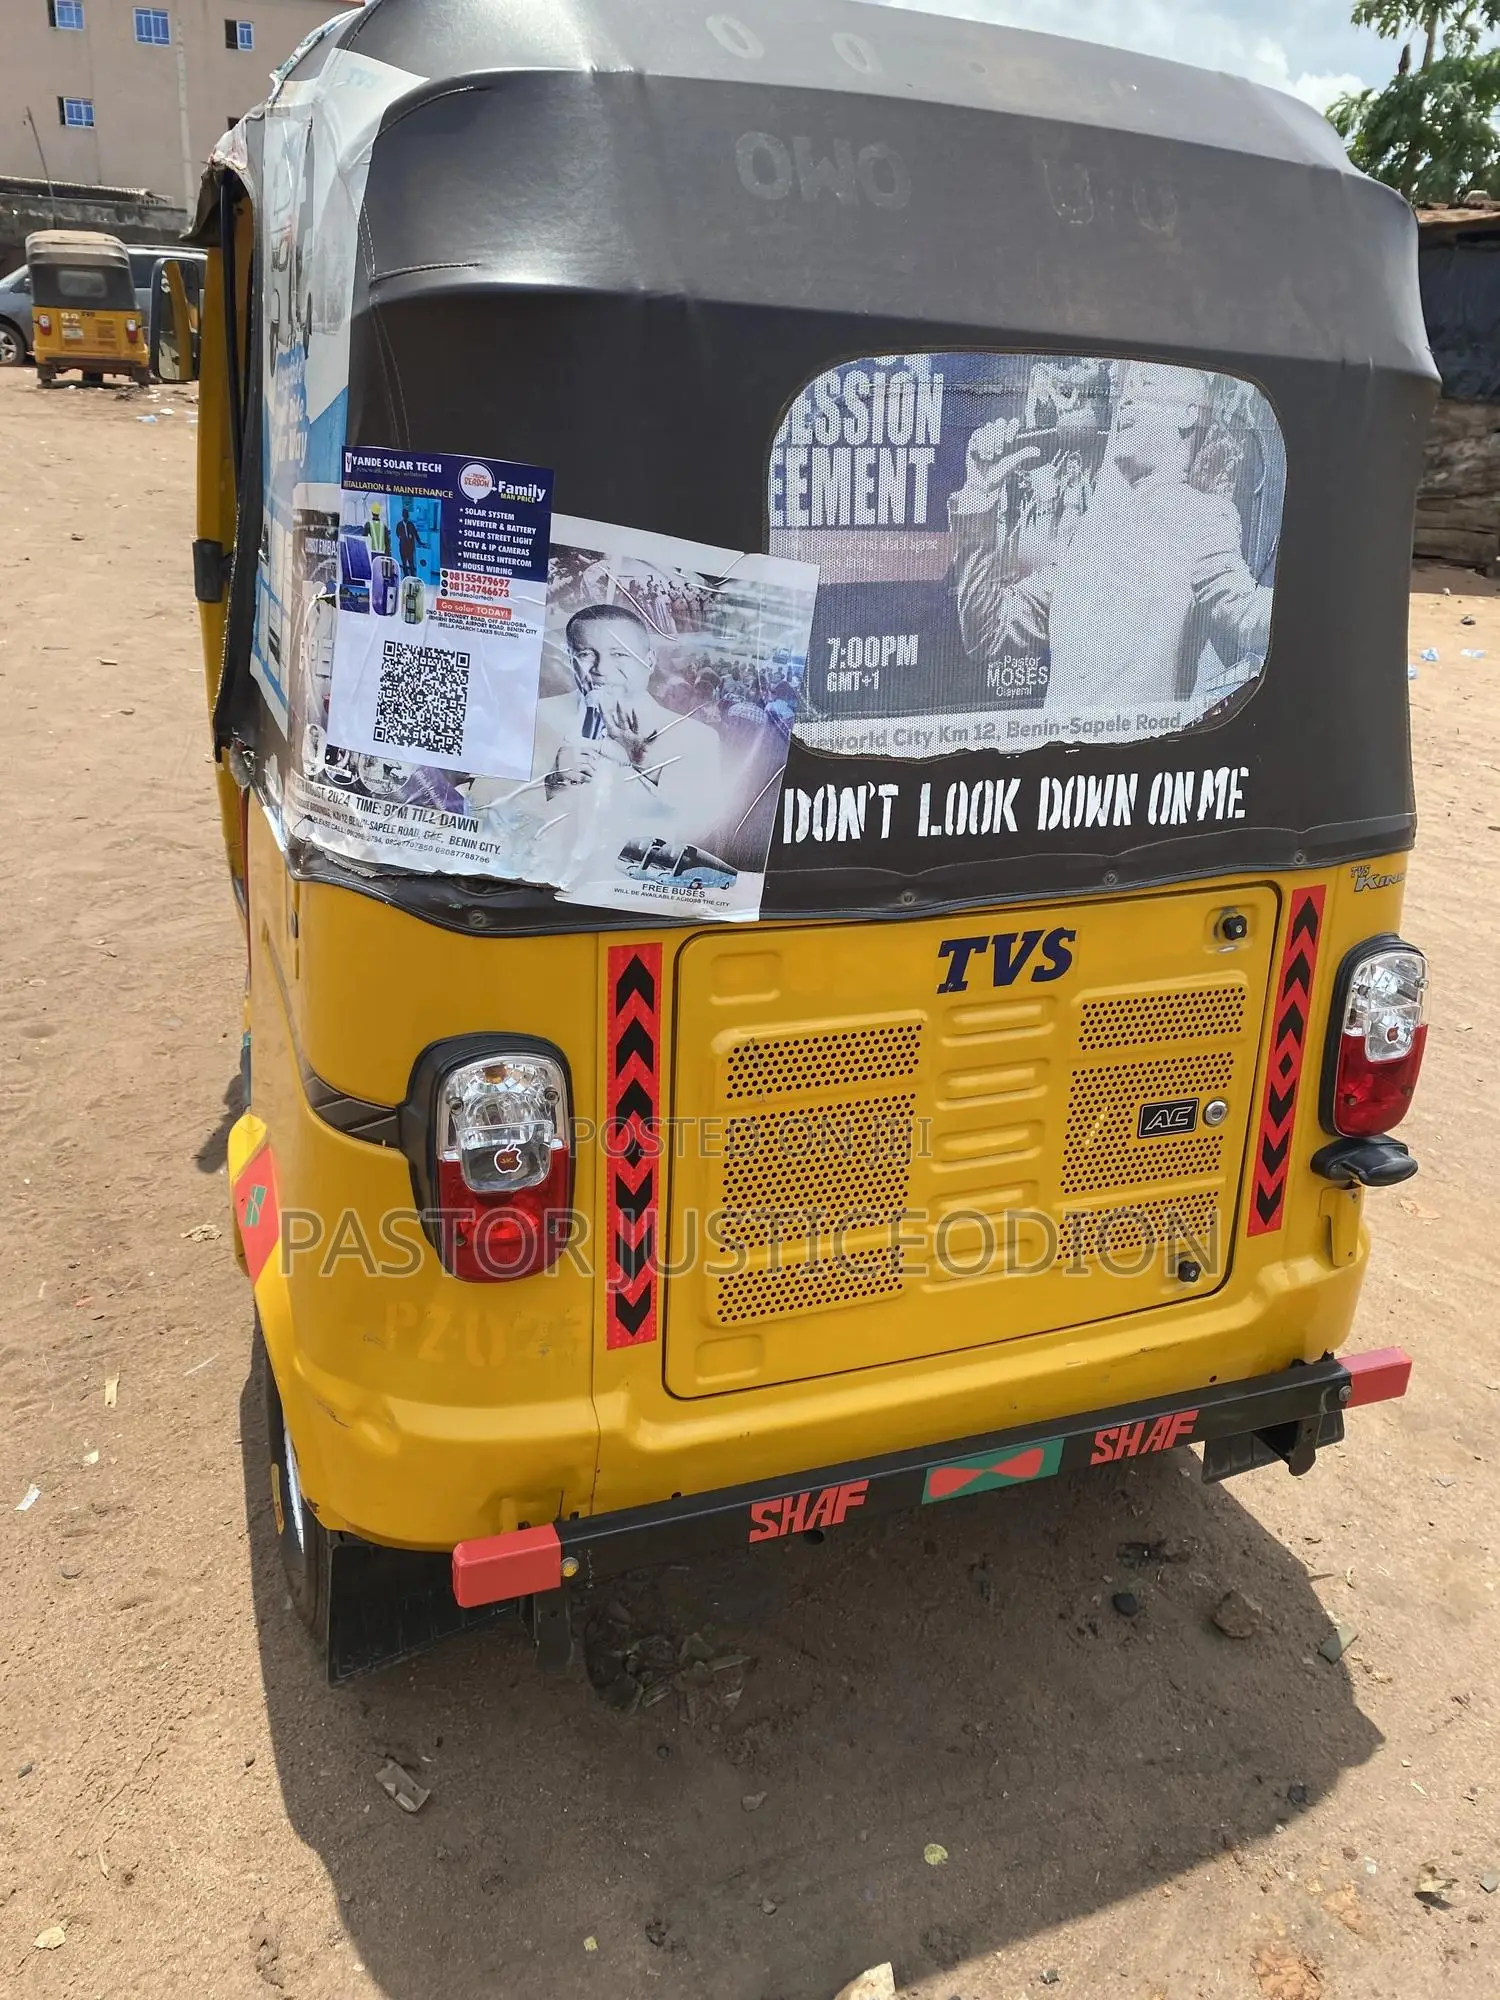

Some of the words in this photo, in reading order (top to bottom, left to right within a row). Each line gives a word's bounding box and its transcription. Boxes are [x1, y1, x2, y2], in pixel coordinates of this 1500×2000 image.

[383, 458, 413, 470] SOLAR
[416, 461, 442, 473] TECH
[393, 485, 454, 498] MAINTENANCE
[498, 481, 546, 501] Family
[517, 495, 535, 503] PRICE
[464, 508, 486, 517] SOLAR
[488, 511, 514, 520] SYSTEM
[464, 519, 497, 529] INVERTER
[499, 523, 504, 531] &
[507, 524, 536, 535] BATTERY
[463, 530, 485, 539] SOLAR
[487, 533, 511, 542] STREET
[513, 536, 533, 545] LIGHT
[463, 541, 480, 549] CCTV
[498, 545, 530, 556] CAMERAS
[463, 551, 495, 562] WIRELESS
[497, 557, 532, 567] INTERCOM
[462, 562, 484, 572] HOUSE
[486, 565, 513, 575] WIRING
[450, 572, 510, 588] 08155479697
[449, 582, 509, 597] 08134746673
[441, 602, 453, 610] Go
[477, 607, 508, 617] TODAY!
[827, 634, 919, 669] 7:00PM
[1003, 655, 1041, 669] Pastor
[827, 669, 880, 693] GMT+1
[987, 666, 1049, 687] MOSES
[893, 727, 934, 749] City
[940, 725, 968, 743] Km
[973, 722, 1000, 742] 12,
[1006, 714, 1132, 739] Benin-Sapele
[783, 780, 899, 844] DON'T
[917, 778, 1021, 837] LOOK
[1037, 772, 1138, 831] DOWN
[1147, 770, 1195, 826] ON
[1196, 766, 1249, 821] ME
[356, 796, 381, 815] TIME:
[384, 803, 408, 819] 8PM
[412, 808, 436, 824] TILL
[440, 813, 479, 833] DAWN
[449, 835, 477, 849] BENIN
[479, 841, 501, 855] CITY.
[640, 890, 675, 900] AVAILABLE
[676, 895, 701, 903] ACROSS
[642, 883, 669, 893] FREE
[671, 887, 706, 898] BUSES
[936, 926, 1076, 994] TVS
[1144, 1105, 1194, 1132] AC
[1089, 1408, 1200, 1465] SHAF
[748, 1479, 870, 1543] SHAF
